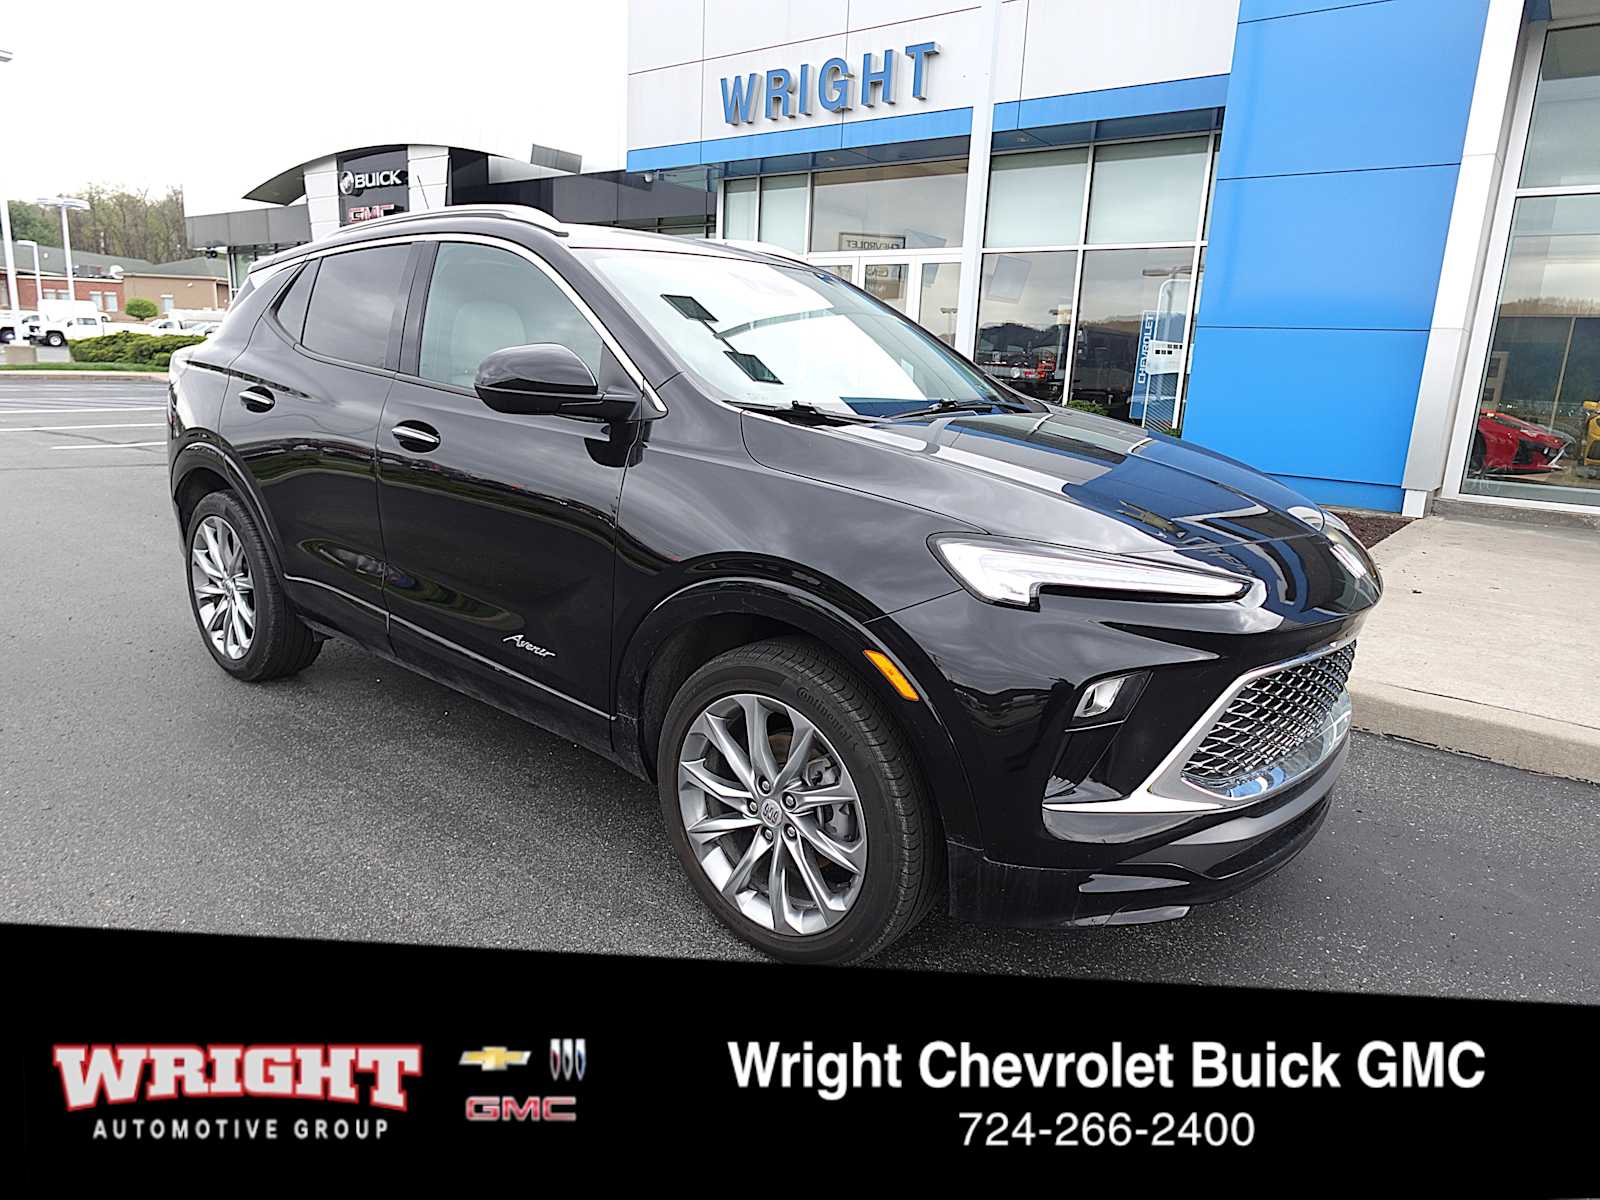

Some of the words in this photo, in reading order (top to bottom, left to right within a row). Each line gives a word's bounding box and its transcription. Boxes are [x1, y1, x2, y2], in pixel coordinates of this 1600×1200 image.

[720, 41, 939, 126] WRIGHT
[354, 170, 401, 188] BUICK
[1138, 314, 1154, 384] CHEVROLET
[502, 634, 556, 657] Avenir
[797, 687, 853, 742] Continental
